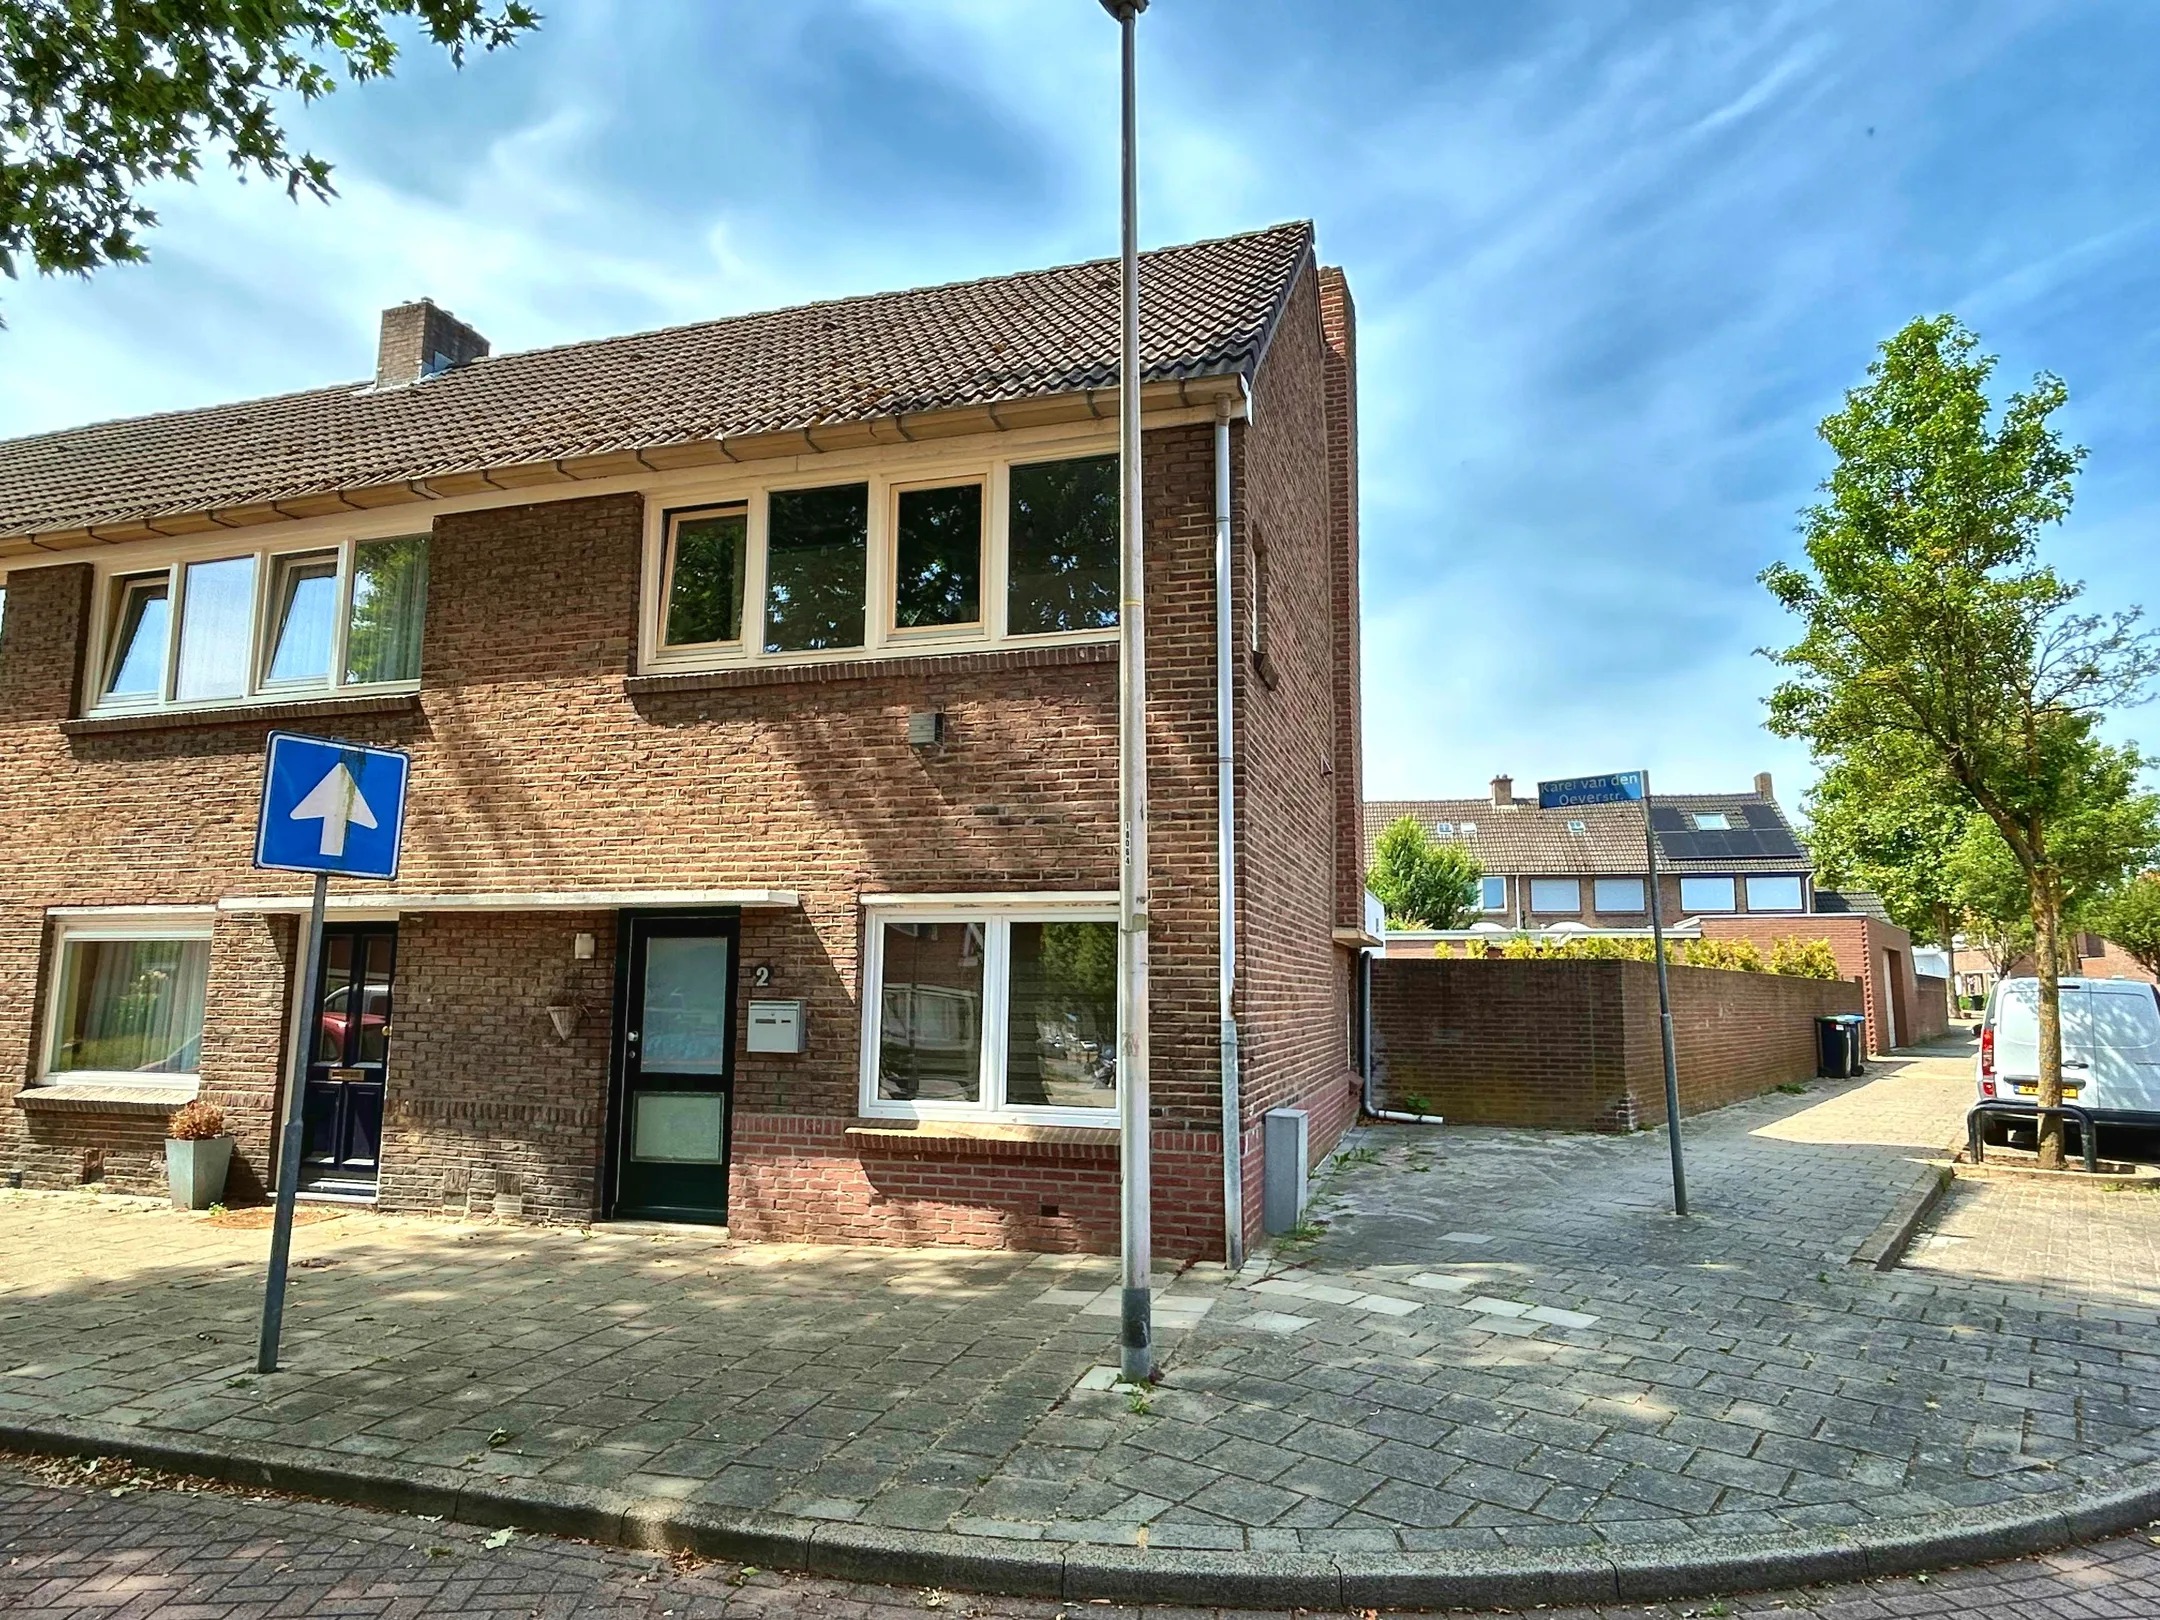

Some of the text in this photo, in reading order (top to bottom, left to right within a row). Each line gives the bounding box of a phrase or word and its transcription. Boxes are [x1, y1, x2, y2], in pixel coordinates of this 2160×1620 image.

[1540, 774, 1638, 794] Karel van den
[756, 967, 769, 987] 2
